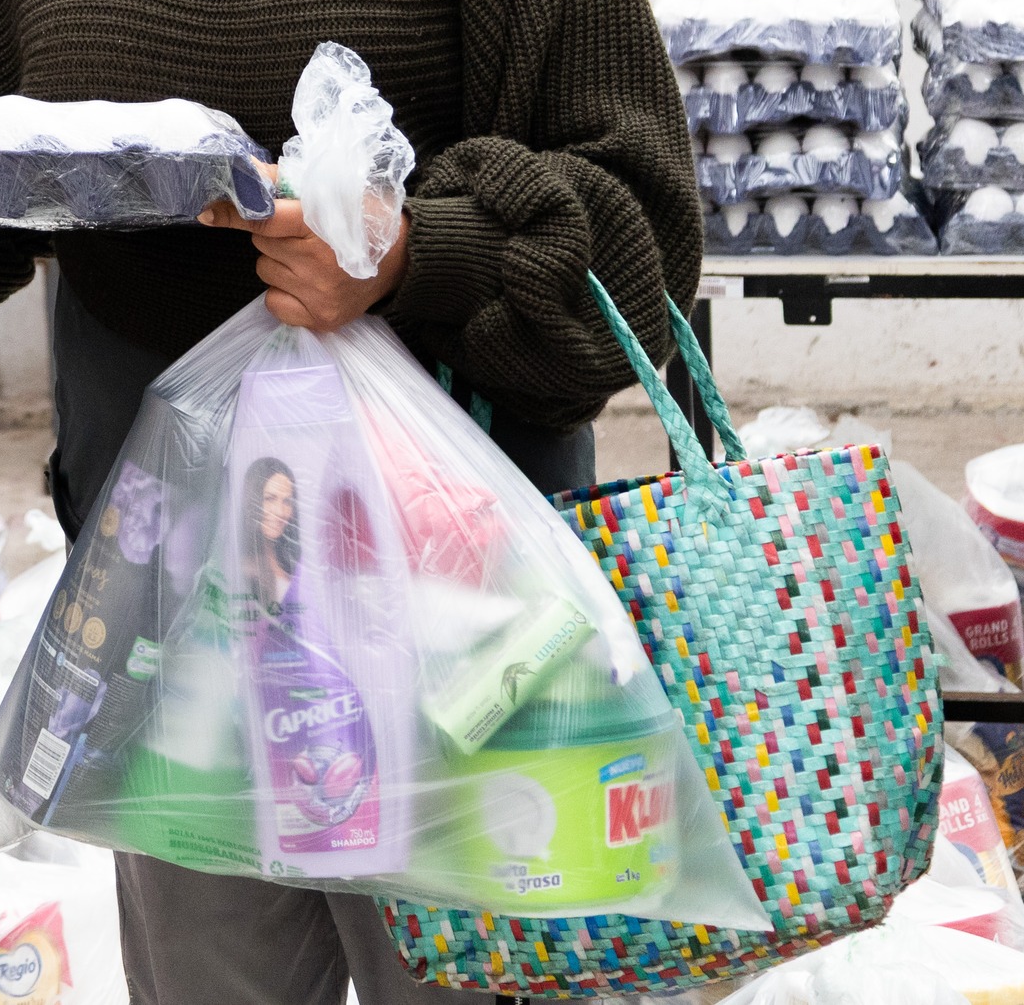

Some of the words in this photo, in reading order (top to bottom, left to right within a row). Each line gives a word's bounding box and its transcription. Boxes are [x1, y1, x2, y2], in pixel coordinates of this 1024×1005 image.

[964, 618, 1009, 639] GRAND
[536, 621, 576, 662] Cream
[969, 631, 1010, 651] ROLLS
[265, 692, 359, 743] CAPRICE
[938, 797, 970, 819] AND
[350, 828, 364, 840] 750
[938, 813, 975, 836] OLLS
[331, 836, 376, 849] SHAMPOO
[519, 874, 561, 894] grasa
